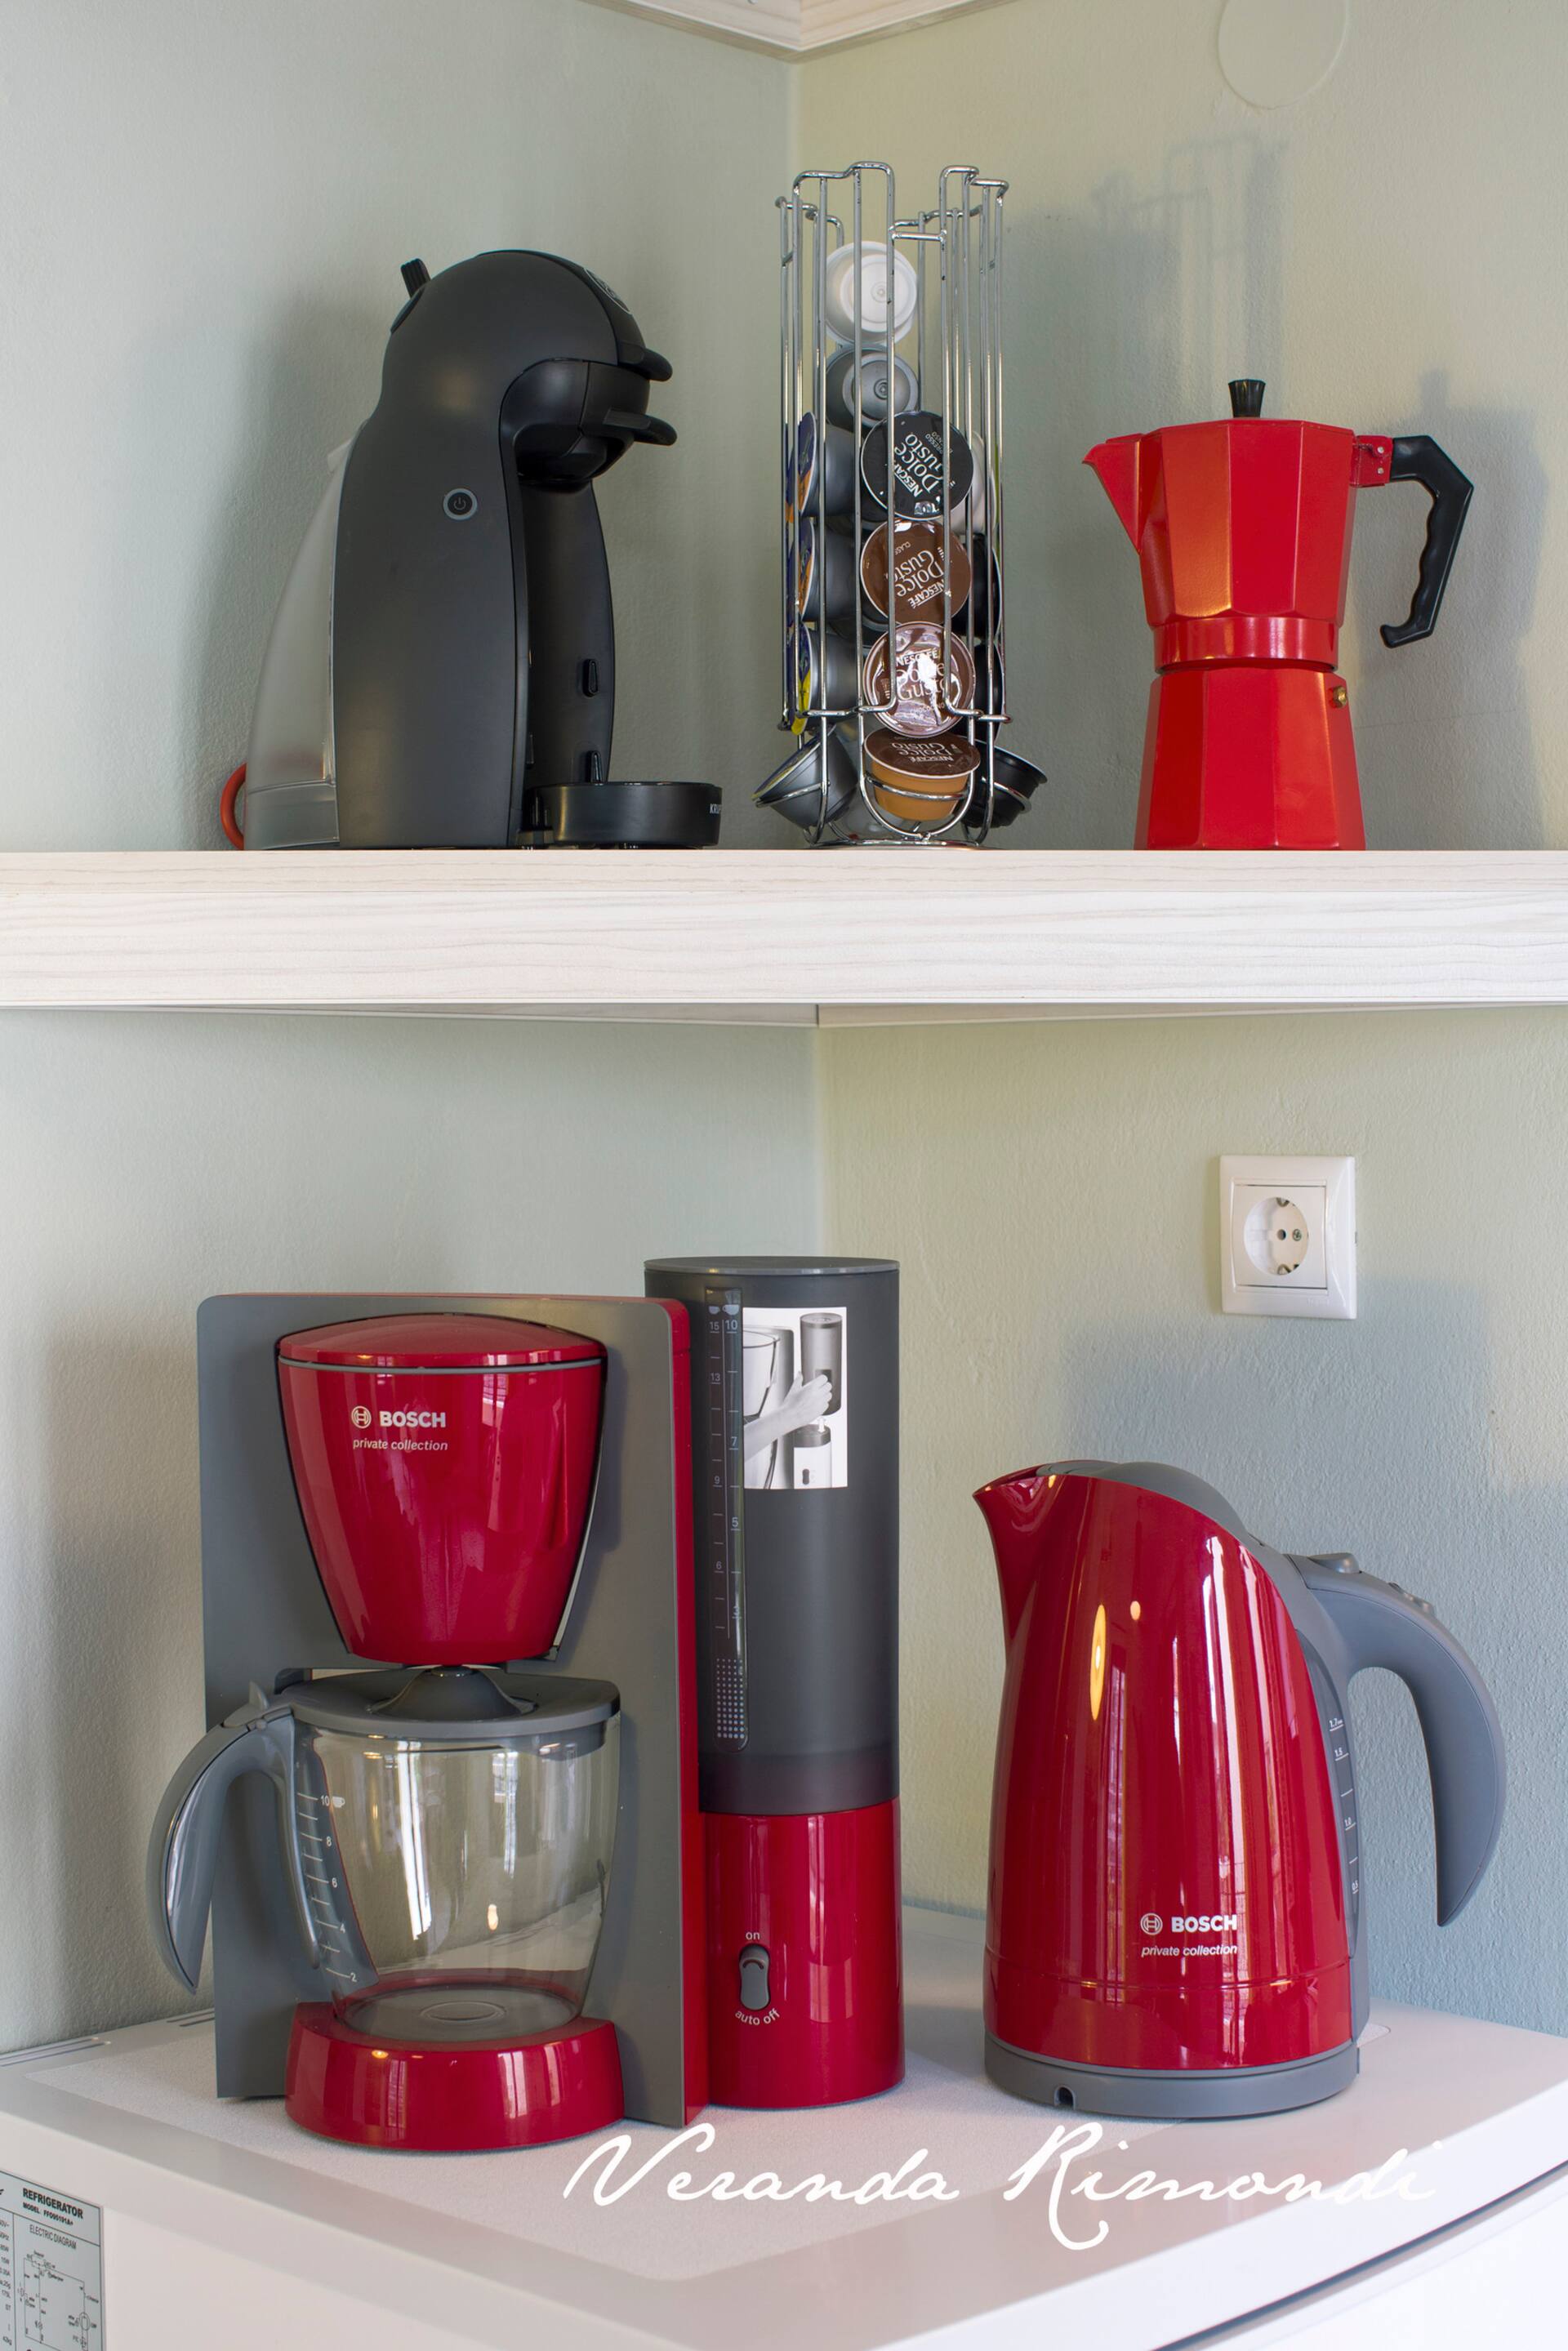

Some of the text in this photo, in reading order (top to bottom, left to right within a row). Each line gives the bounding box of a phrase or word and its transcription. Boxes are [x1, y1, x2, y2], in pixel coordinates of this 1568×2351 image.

[895, 561, 944, 597] Dolce
[891, 741, 946, 751] Gusto
[898, 747, 953, 757] Dolce
[709, 1320, 720, 1331] 15
[724, 1319, 738, 1331] 10
[710, 1373, 721, 1383] 13
[379, 1410, 447, 1428] BOSCH
[353, 1437, 448, 1451] private collection
[731, 1436, 738, 1447] 7
[714, 1475, 720, 1485] 9
[715, 1561, 723, 1570] 6
[319, 1795, 331, 1807] 10
[1171, 1914, 1237, 1933] BOSCH
[745, 1931, 760, 1940] on
[1141, 1944, 1238, 1957] private collection
[350, 1972, 358, 1983] 2
[735, 2007, 781, 2026] auto off
[22, 2187, 84, 2220] REFRIGERATOR
[29, 2224, 77, 2250] ELECTRIC DIAGRAM
